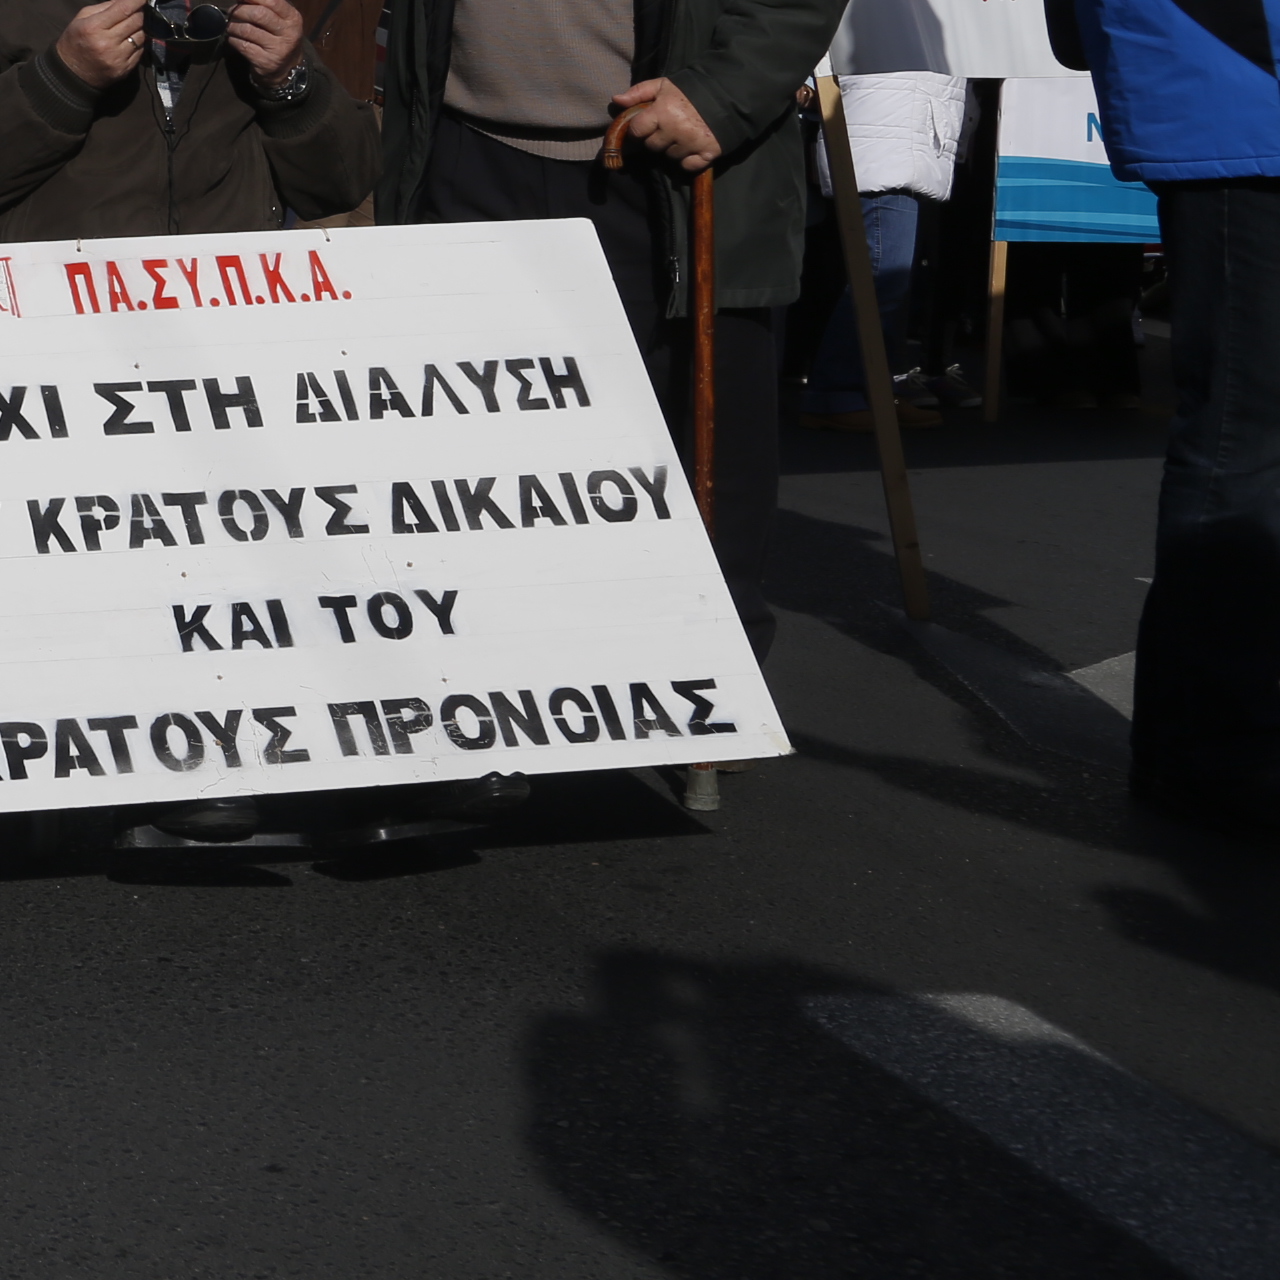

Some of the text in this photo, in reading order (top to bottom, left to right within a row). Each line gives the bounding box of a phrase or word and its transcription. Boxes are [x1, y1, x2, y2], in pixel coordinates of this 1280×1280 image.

[93, 376, 264, 436] ΣΤΗ
[295, 357, 591, 424] ΔΙΑΛΥΣΗ
[27, 485, 370, 554] ΚΡΑΤΟΥΣ
[391, 465, 673, 534] ΔΙΚΑΙΟΥ
[172, 589, 459, 653] ΚΑΙ ΤΟΥ
[327, 679, 737, 756] ΠΡΟΝΟΙΑΣ
